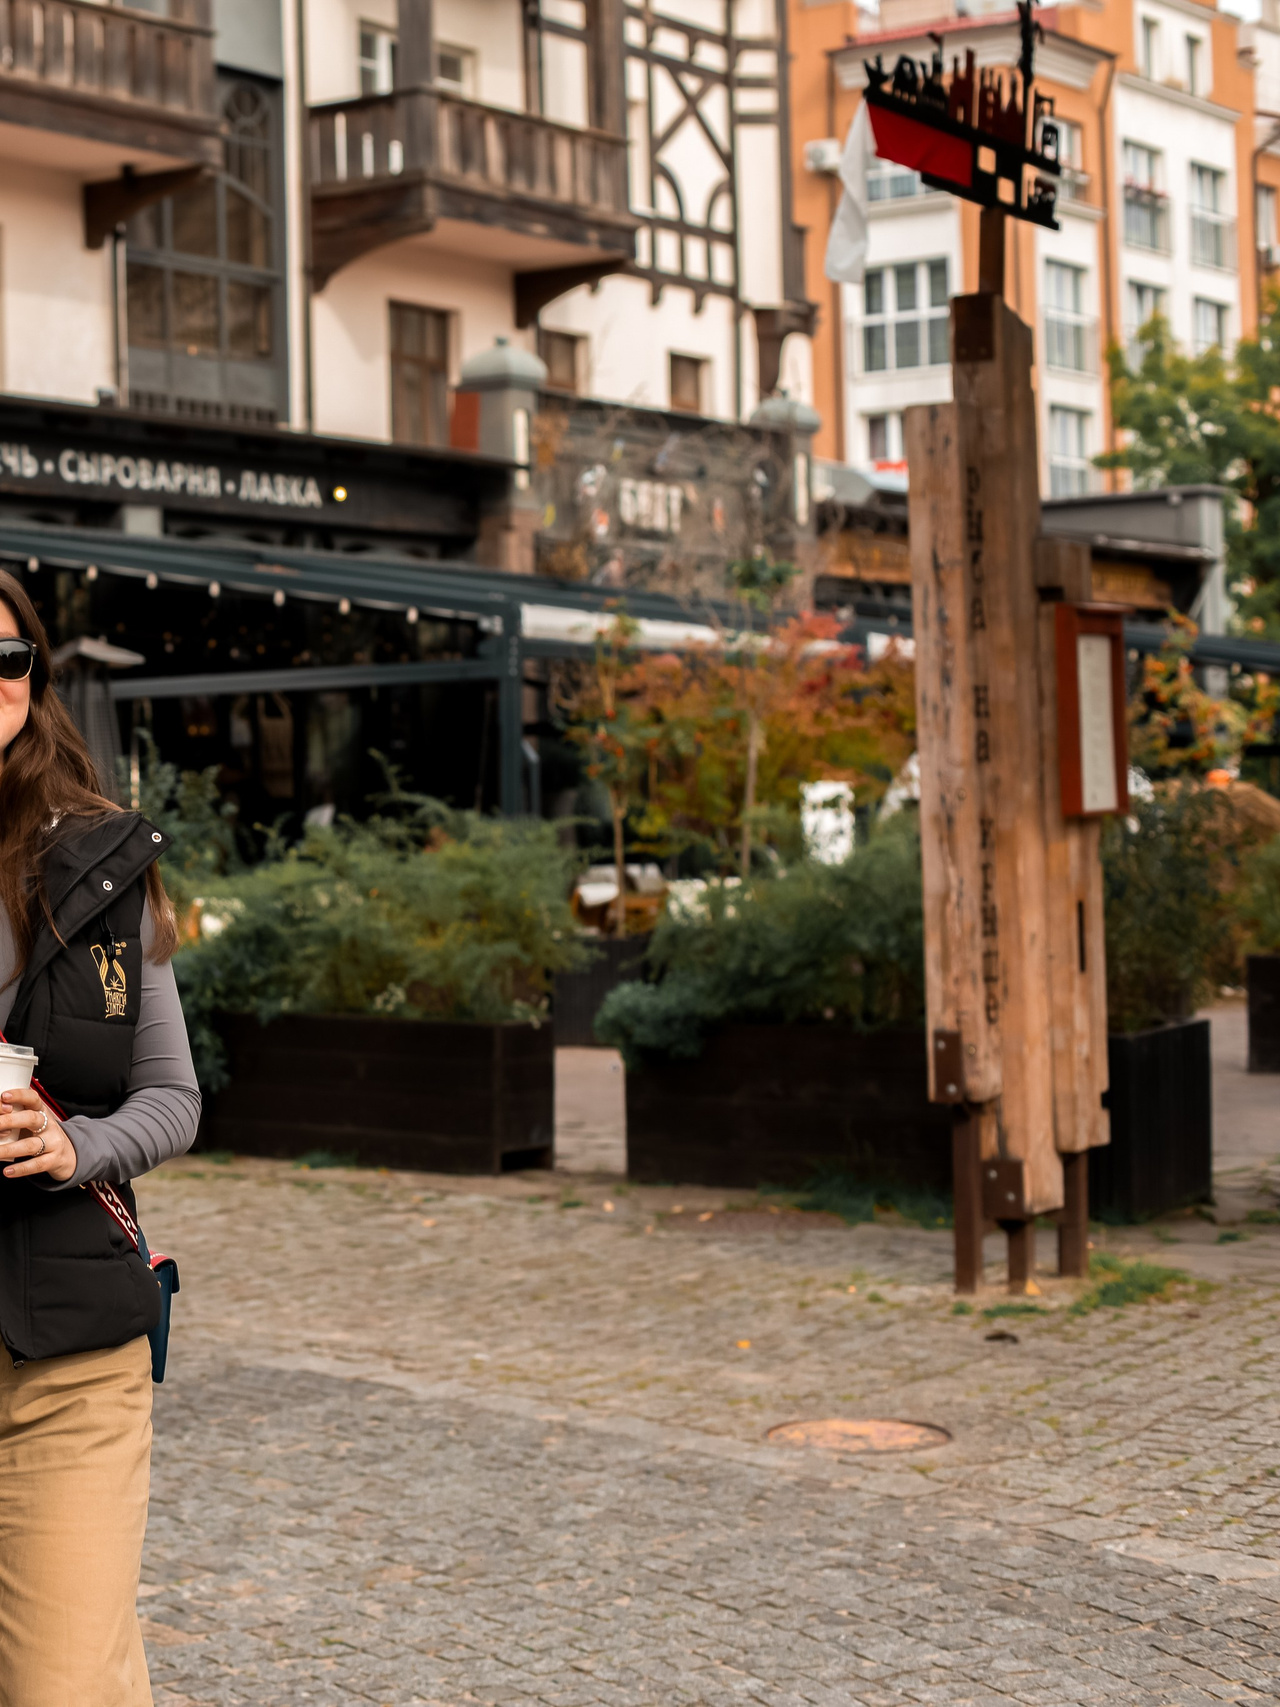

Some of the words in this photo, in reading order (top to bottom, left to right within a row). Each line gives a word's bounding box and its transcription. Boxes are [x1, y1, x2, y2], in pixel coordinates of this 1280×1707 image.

[58, 449, 221, 499] СЫРОВАРНЯ
[239, 469, 322, 508] ЛАВКА
[105, 990, 127, 1006] PHARMA
